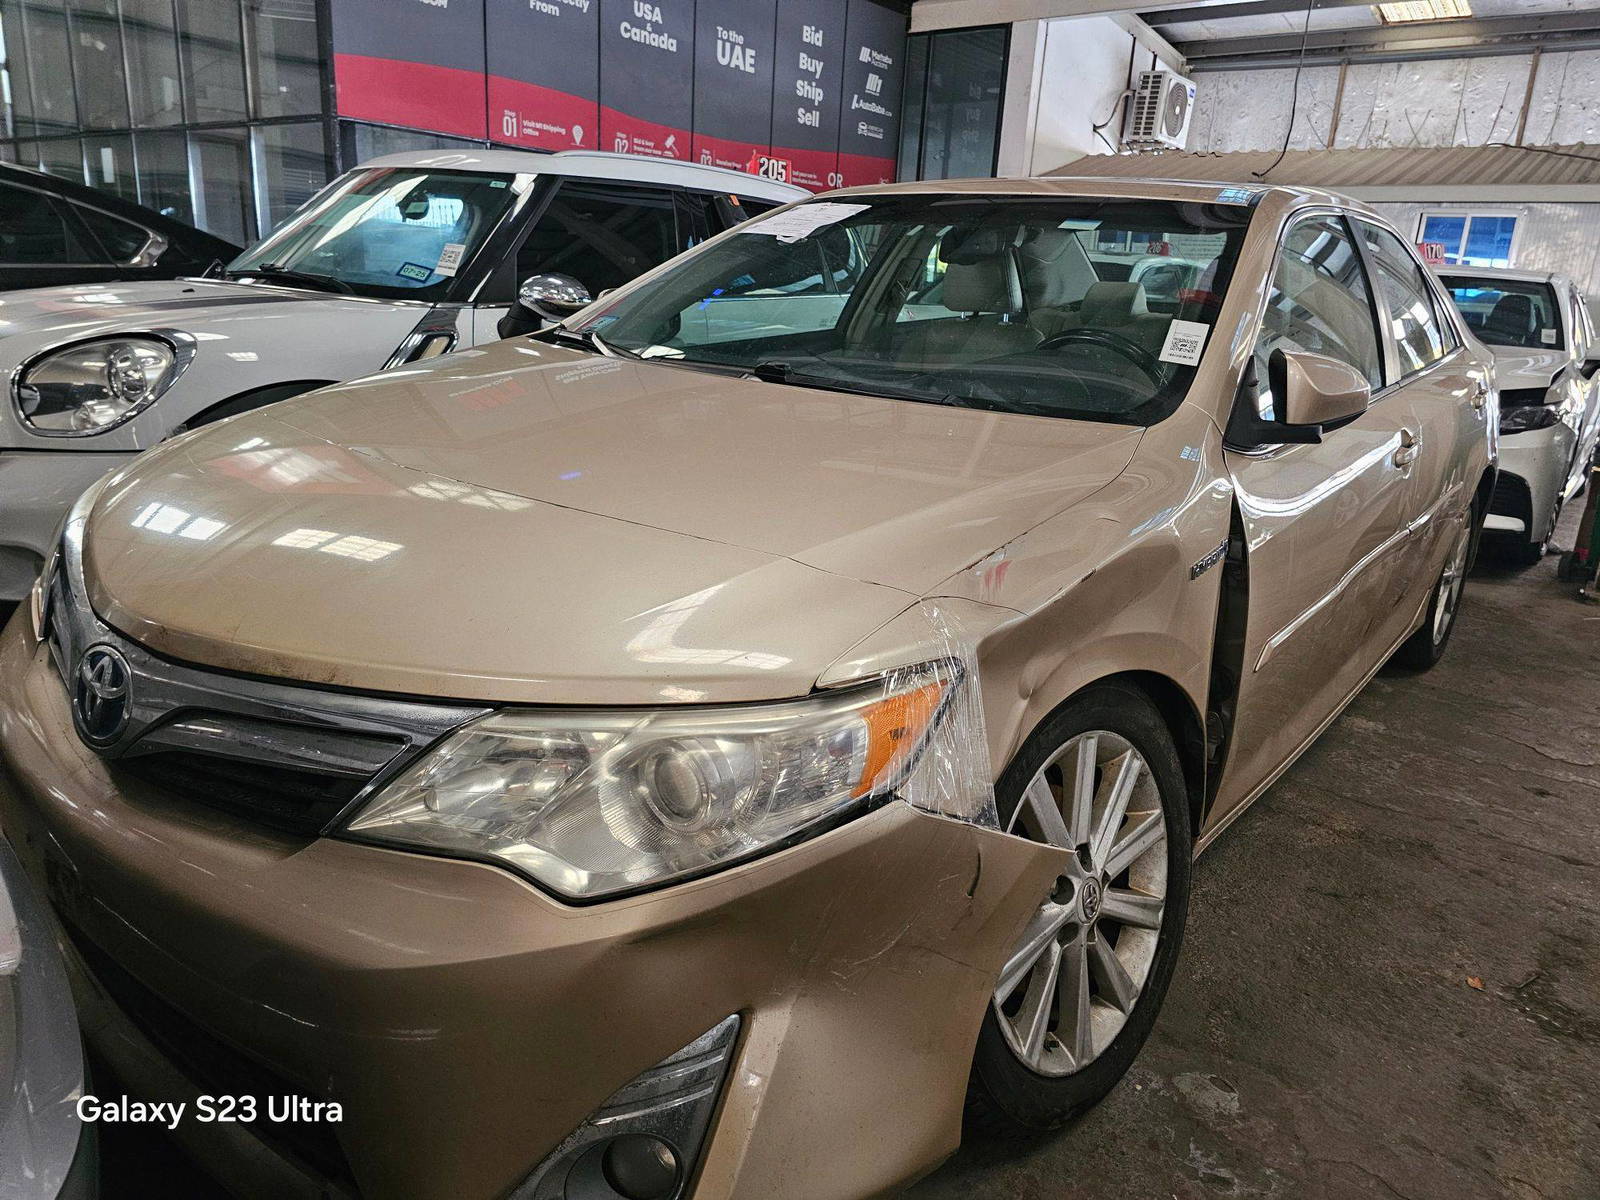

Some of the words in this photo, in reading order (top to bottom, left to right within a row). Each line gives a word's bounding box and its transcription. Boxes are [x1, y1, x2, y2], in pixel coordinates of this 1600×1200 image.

[530, 0, 560, 17] From
[633, 0, 663, 25] USA
[620, 21, 677, 53] Canada
[716, 25, 728, 40] To
[728, 30, 744, 45] the
[802, 25, 823, 48] Bid
[716, 39, 756, 74] UAE
[799, 52, 824, 80] Buy
[796, 79, 824, 107] Ship
[503, 115, 518, 138] 01
[797, 107, 820, 128] Sell
[615, 138, 629, 153] 02
[759, 157, 787, 182] 205
[827, 172, 843, 188] OR
[1427, 244, 1443, 259] 170
